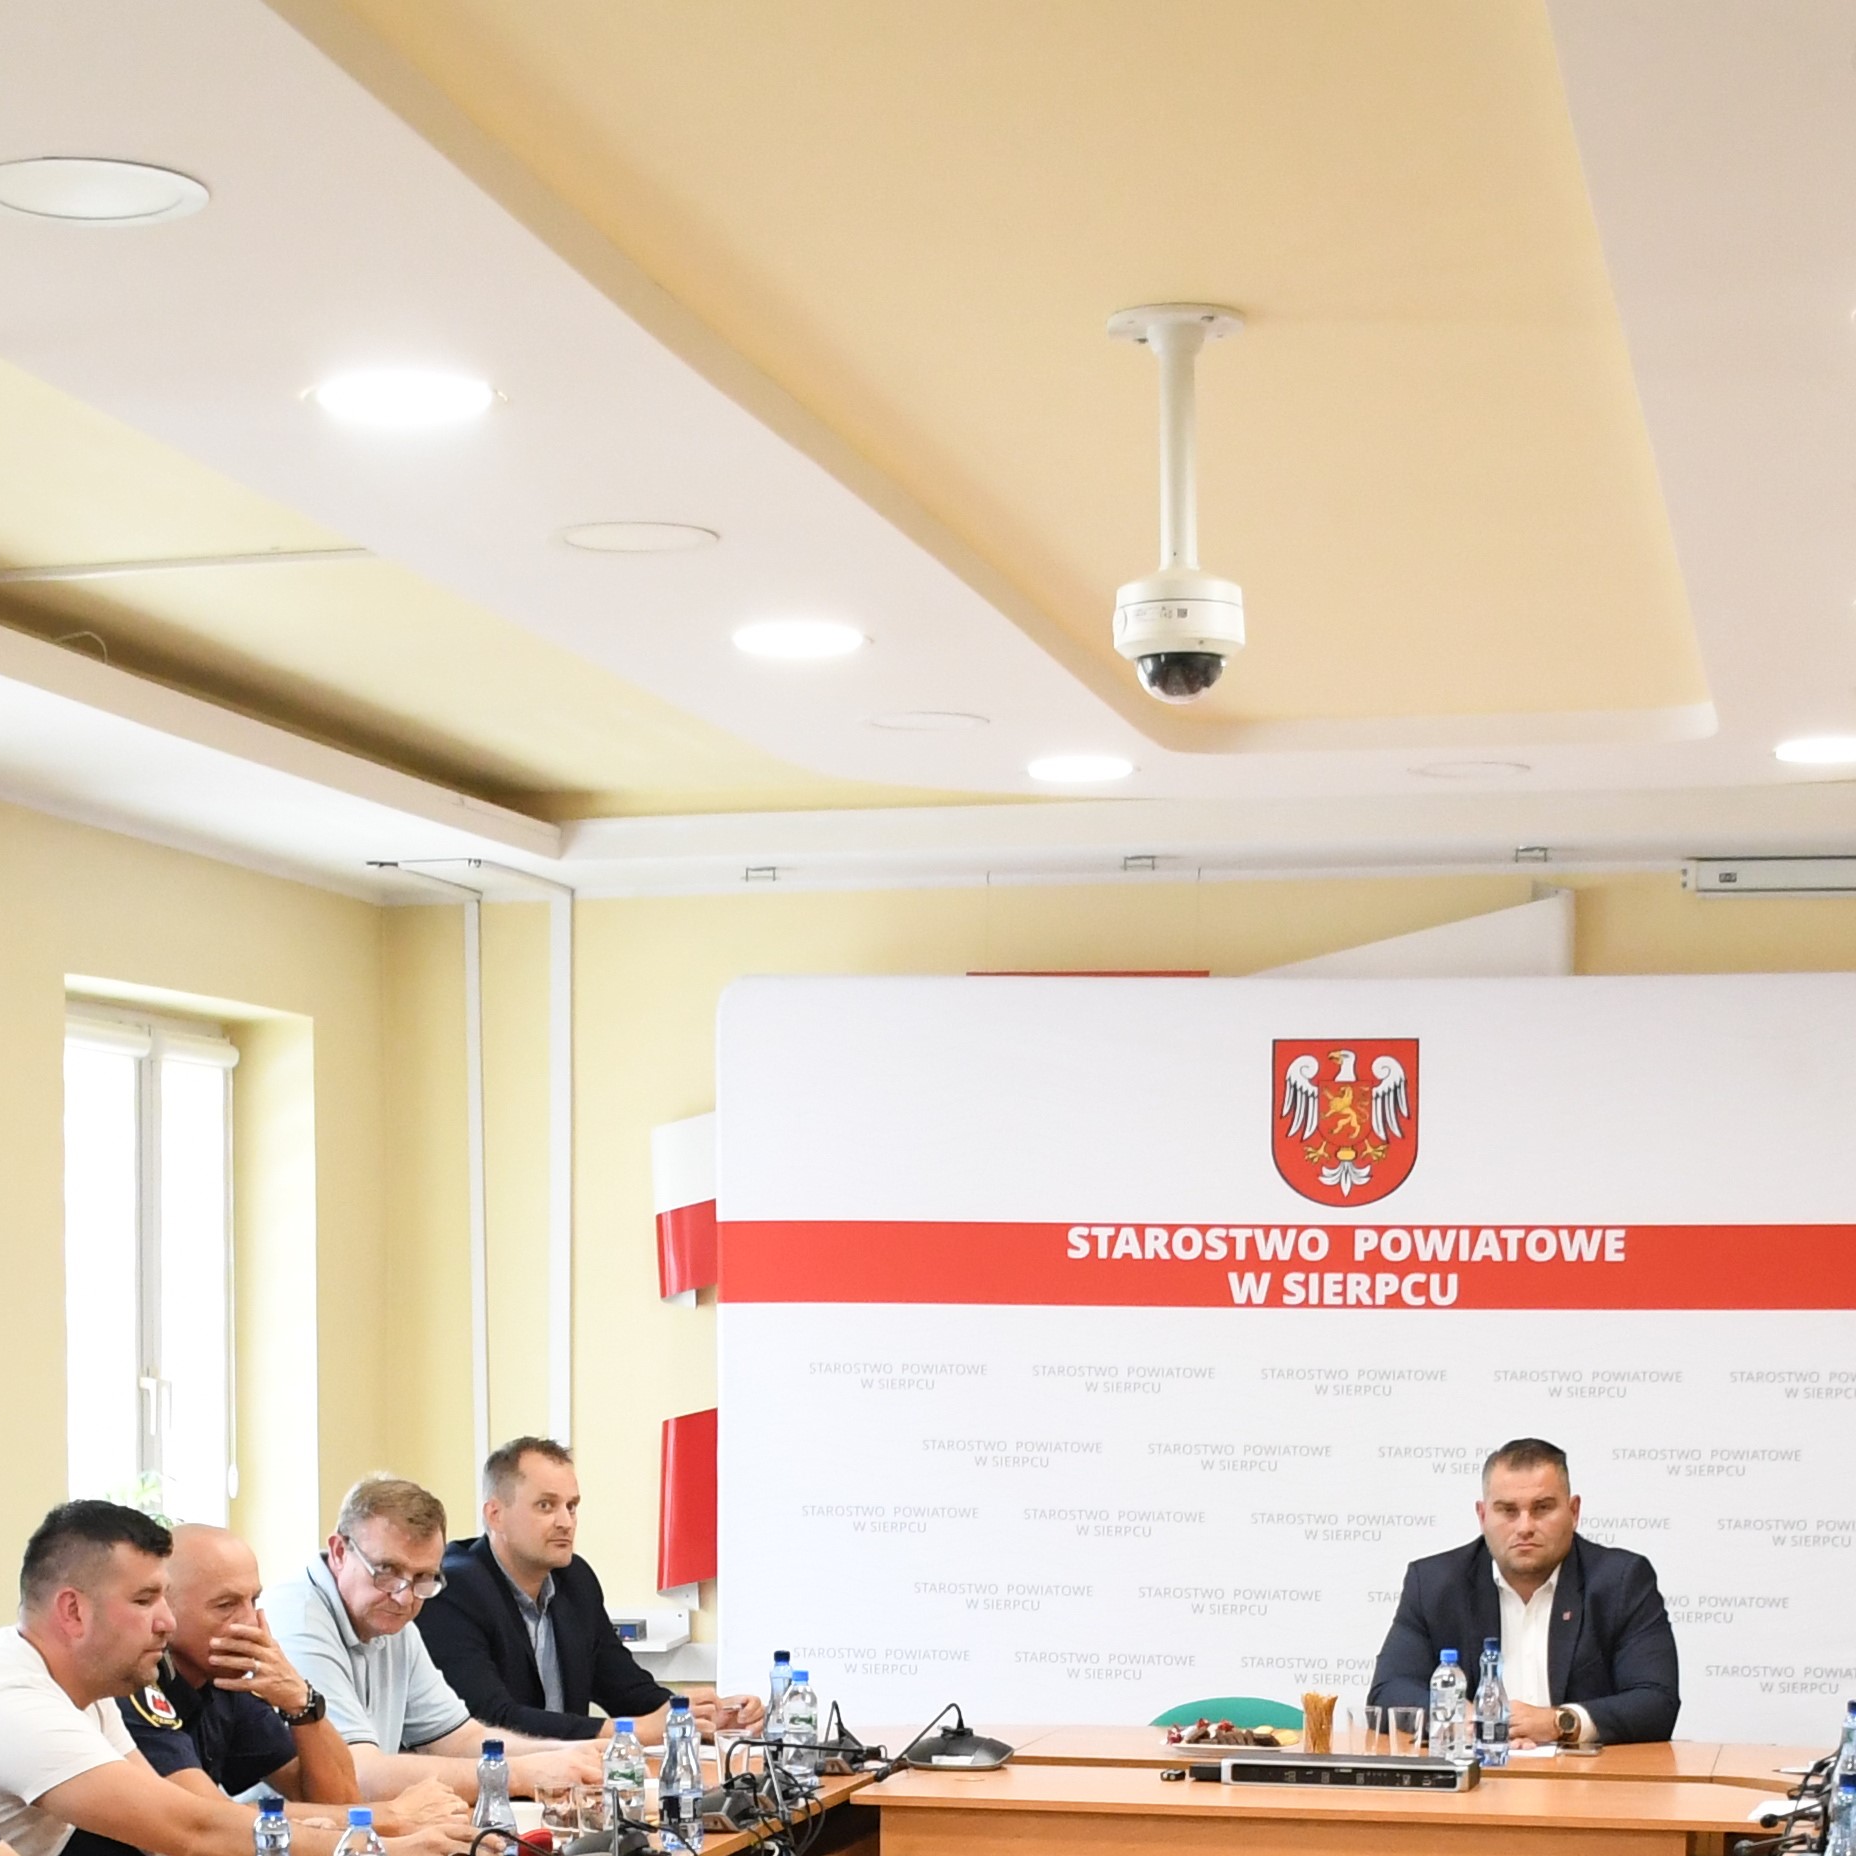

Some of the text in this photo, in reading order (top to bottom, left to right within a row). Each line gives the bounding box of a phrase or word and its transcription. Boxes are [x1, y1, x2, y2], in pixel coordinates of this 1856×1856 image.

[1066, 1227, 1626, 1262] STAROSTWO POWIATOWE
[1228, 1272, 1459, 1306] W SIERPCU
[809, 1361, 988, 1376] STAROSTWO POWIATOWE
[1032, 1364, 1216, 1380] STAROSTWO POWIATOWE
[1260, 1367, 1448, 1383] STAROSTWO POWIATOWE
[860, 1377, 935, 1391] W SIERPCU
[1493, 1369, 1684, 1384] STAROSTWO POWIATOWE
[1729, 1370, 1821, 1384] STAROSTWO
[1084, 1380, 1162, 1395] W SIERPCU
[1314, 1383, 1393, 1397] W SIERPCU
[1547, 1385, 1627, 1399] W SIERPCU
[1784, 1386, 1801, 1399] W
[922, 1439, 1103, 1454] STAROSTWO POWIATOWE
[1147, 1442, 1332, 1458] STAROSTWO POWIATOWE
[1377, 1445, 1467, 1459] STAROSTWO
[974, 1455, 1050, 1469] W SIERPCU
[1611, 1447, 1802, 1463] STAROSTWO POWIATOWE
[1200, 1458, 1278, 1473] W SIERPCU
[1431, 1462, 1482, 1475] W SIER
[1666, 1463, 1746, 1478] W SIERPCU
[801, 1504, 979, 1519] STAROSTWO POWIATOWE
[1023, 1508, 1206, 1524] STAROSTWO POWIATOWE
[852, 1520, 927, 1534] W SIERPCU
[1250, 1511, 1437, 1528] STAROSTWO POWIATOWE
[1580, 1516, 1672, 1531] POWIATOWE
[1717, 1517, 1808, 1532] STAROSTWO
[1075, 1524, 1152, 1538] W SIERPCU
[1304, 1528, 1382, 1542] W SIERPCU
[1771, 1534, 1852, 1549] W SIERPCU
[913, 1581, 1094, 1597] STAROSTWO POWIATOWE
[1138, 1586, 1322, 1603] STAROSTWO POWIATOWE
[965, 1598, 1041, 1612] W SIERPCU
[1190, 1602, 1268, 1617] W SIERPCU
[1698, 1595, 1790, 1610] POWIATOWE
[1673, 1610, 1734, 1625] SIERPCU
[792, 1646, 970, 1662] STAROSTWO POWIATOWE
[1014, 1650, 1196, 1667] STAROSTWO POWIATOWE
[843, 1662, 919, 1676] W SIERPCU
[1240, 1655, 1329, 1670] STAROSTWO
[1066, 1667, 1143, 1681] W SIERPCU
[1704, 1664, 1796, 1679] STAROSTWO
[1293, 1672, 1371, 1687] W SIERPCU
[1759, 1681, 1840, 1695] W SIERPCU
